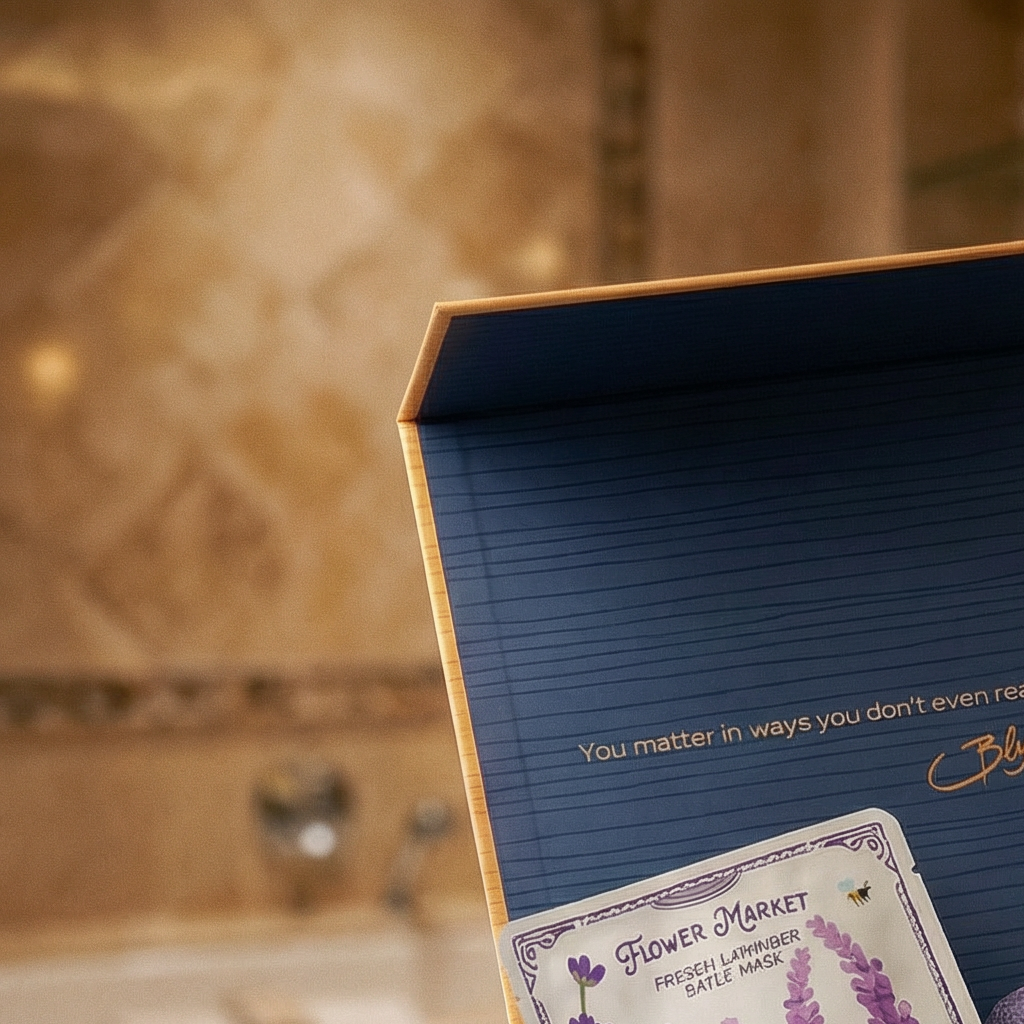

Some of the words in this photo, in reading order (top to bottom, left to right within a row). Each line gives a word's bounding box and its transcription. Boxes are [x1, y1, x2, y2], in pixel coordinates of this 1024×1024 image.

[579, 742, 626, 763] You
[634, 729, 713, 755] matter
[722, 722, 742, 743] in
[749, 714, 812, 741] ways
[817, 707, 861, 734] you
[866, 696, 926, 722] don't
[931, 690, 989, 712] even
[739, 951, 784, 977] MASK
